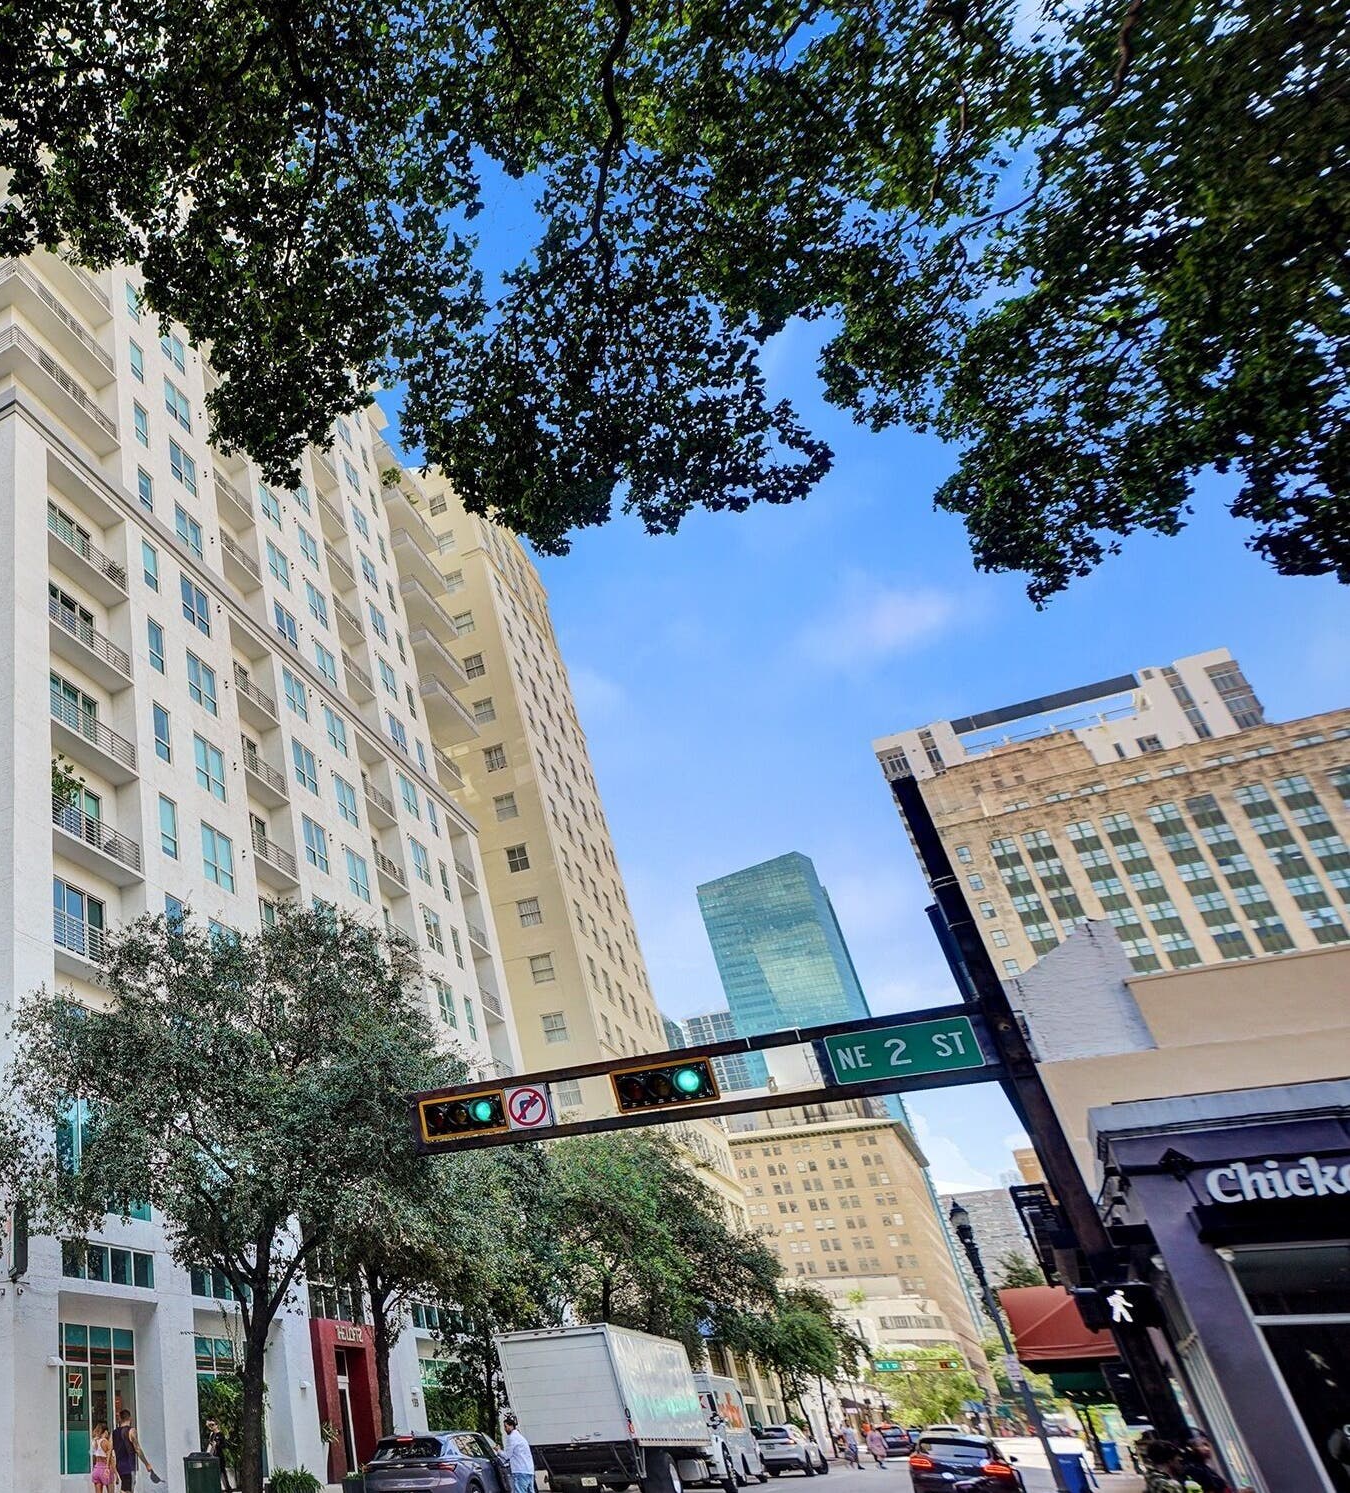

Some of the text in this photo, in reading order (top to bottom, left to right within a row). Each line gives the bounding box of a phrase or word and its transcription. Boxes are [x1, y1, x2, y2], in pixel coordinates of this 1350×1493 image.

[836, 1031, 965, 1070] NE 2 ST
